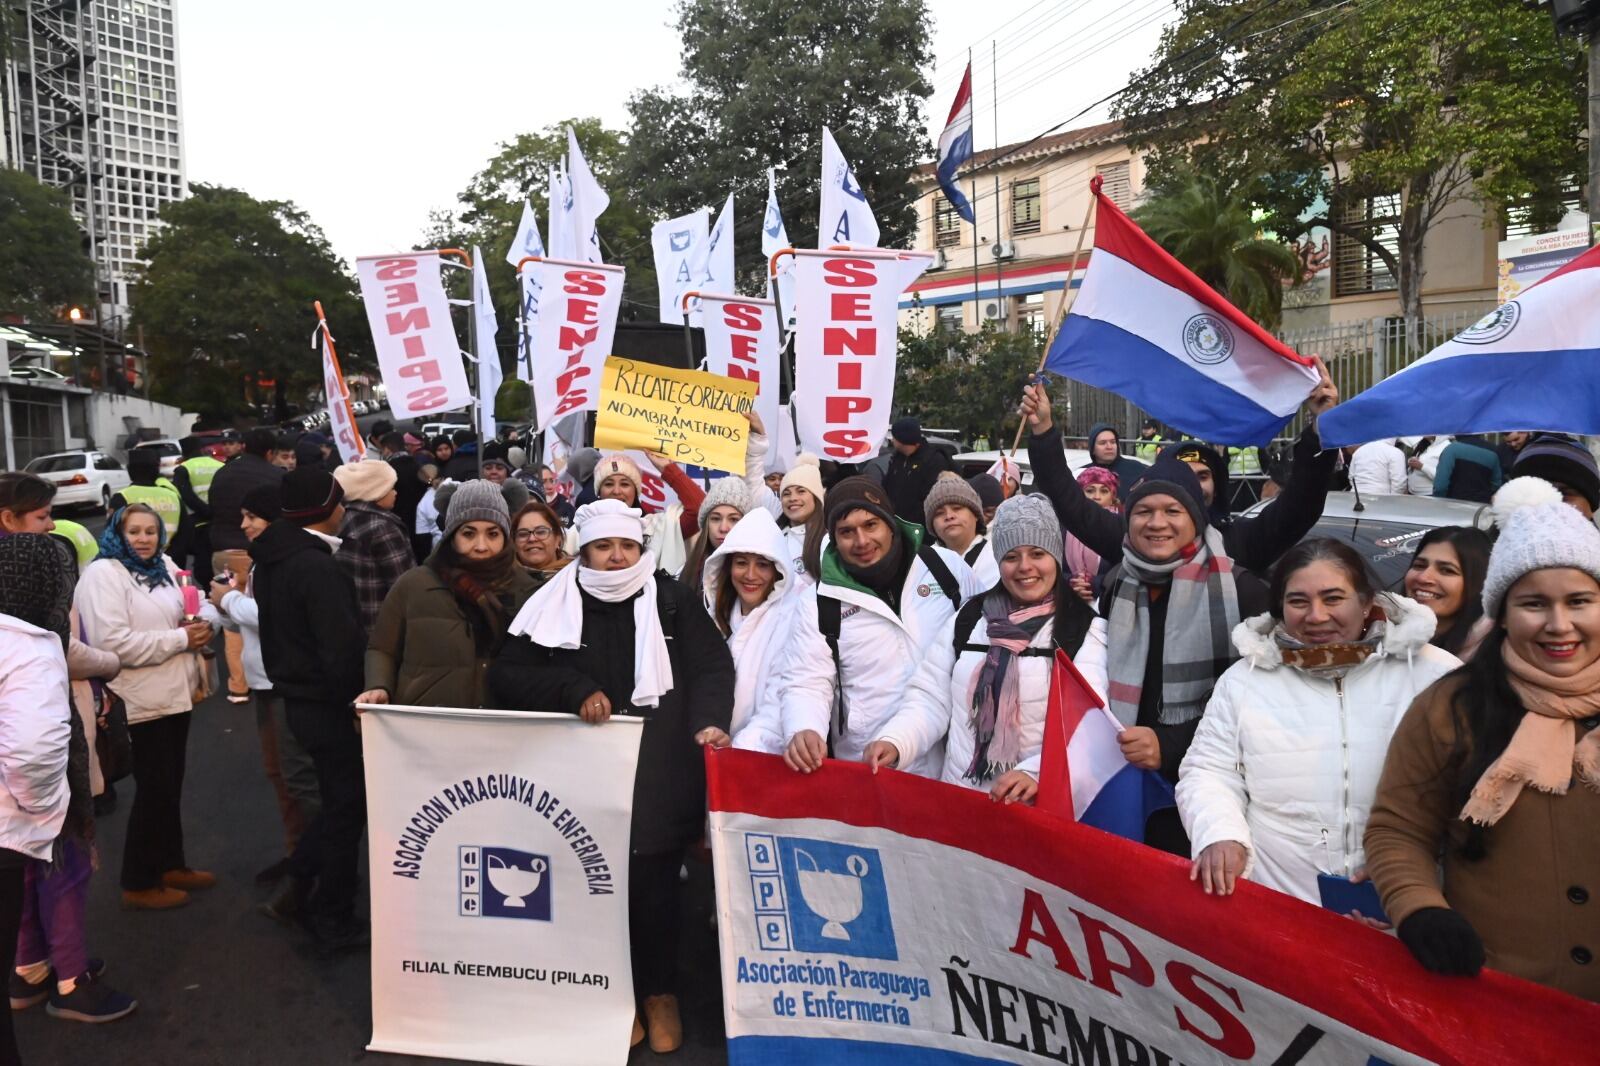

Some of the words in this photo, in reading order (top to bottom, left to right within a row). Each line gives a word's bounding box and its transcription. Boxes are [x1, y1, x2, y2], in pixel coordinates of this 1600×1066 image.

[822, 258, 878, 458] SENIPS
[606, 400, 742, 442] NOMBRAMIENTOS
[674, 405, 683, 415] Y
[656, 426, 688, 441] PARA
[393, 796, 453, 880] ASOCIACION
[443, 774, 535, 810] PARAGUAYA
[535, 790, 560, 820] DE
[552, 808, 614, 895] ENFERMERIA
[402, 960, 450, 975] FILIAL
[454, 960, 547, 982] ÑEEMBUCU
[551, 970, 609, 990] (PILAR)
[737, 956, 836, 986] Asociación
[838, 960, 931, 1001] Paraguaya
[1009, 887, 1256, 1061] APS
[773, 990, 797, 1017] de
[802, 990, 911, 1026] Enfermería
